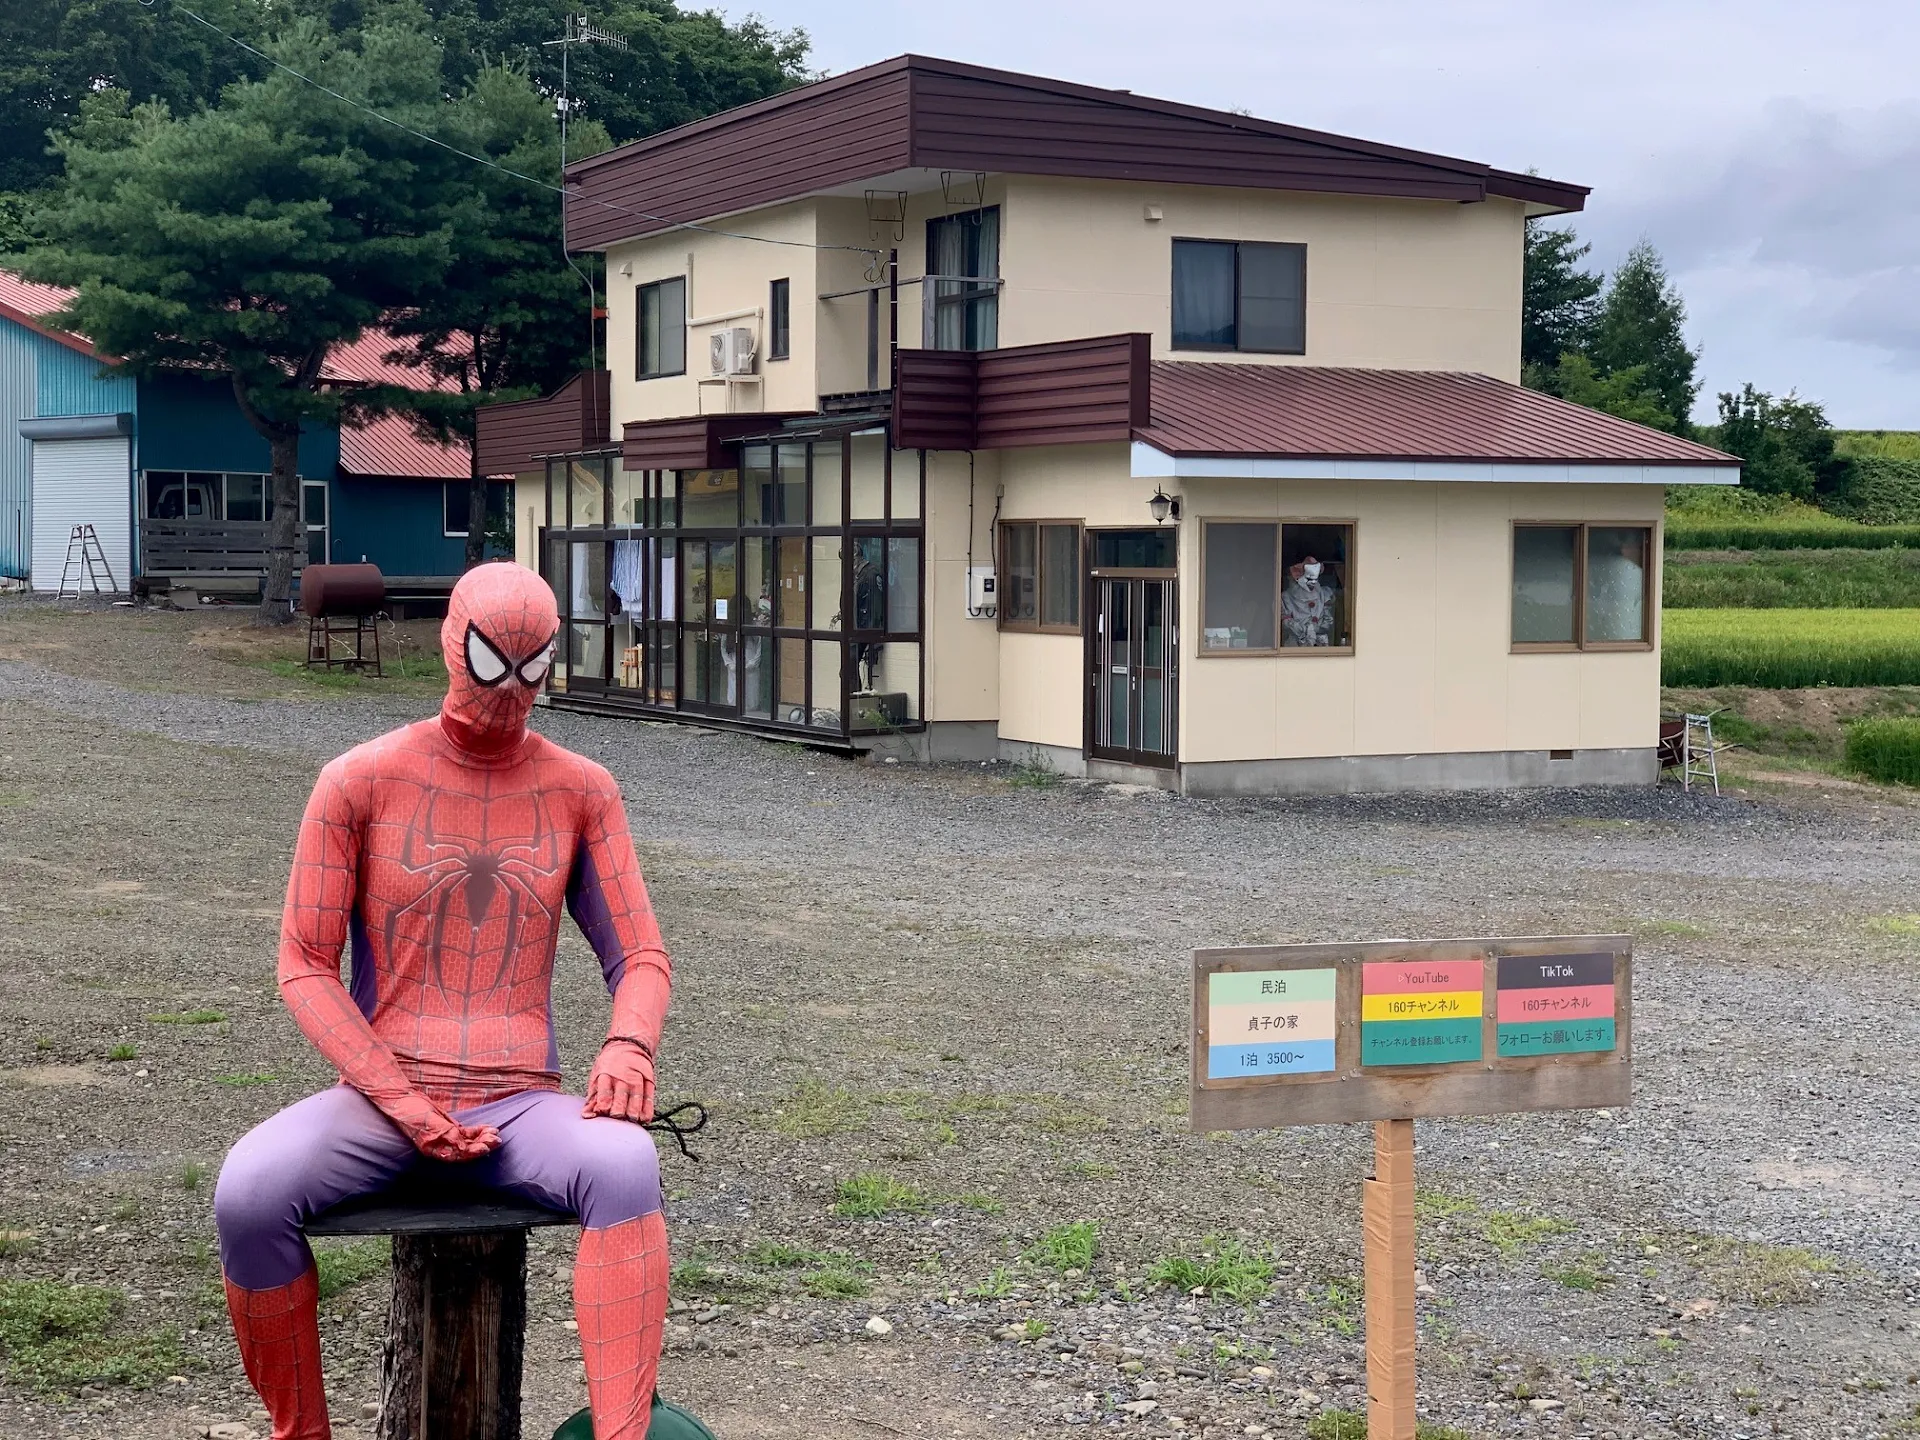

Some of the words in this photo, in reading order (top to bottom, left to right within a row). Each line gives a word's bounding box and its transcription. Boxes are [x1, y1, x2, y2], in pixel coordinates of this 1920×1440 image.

[1404, 972, 1450, 984] YouTube
[1540, 965, 1575, 978] TikTok
[1261, 980, 1287, 994] 民泊
[1388, 998, 1460, 1013] 160チャンネル
[1522, 996, 1592, 1011] 160チャンネル
[1248, 1014, 1299, 1031] 貞子の家
[1370, 1035, 1473, 1048] チャンネル登録お願いします。
[1499, 1026, 1612, 1046] フォローお願いします。
[1240, 1052, 1258, 1067] 1泊
